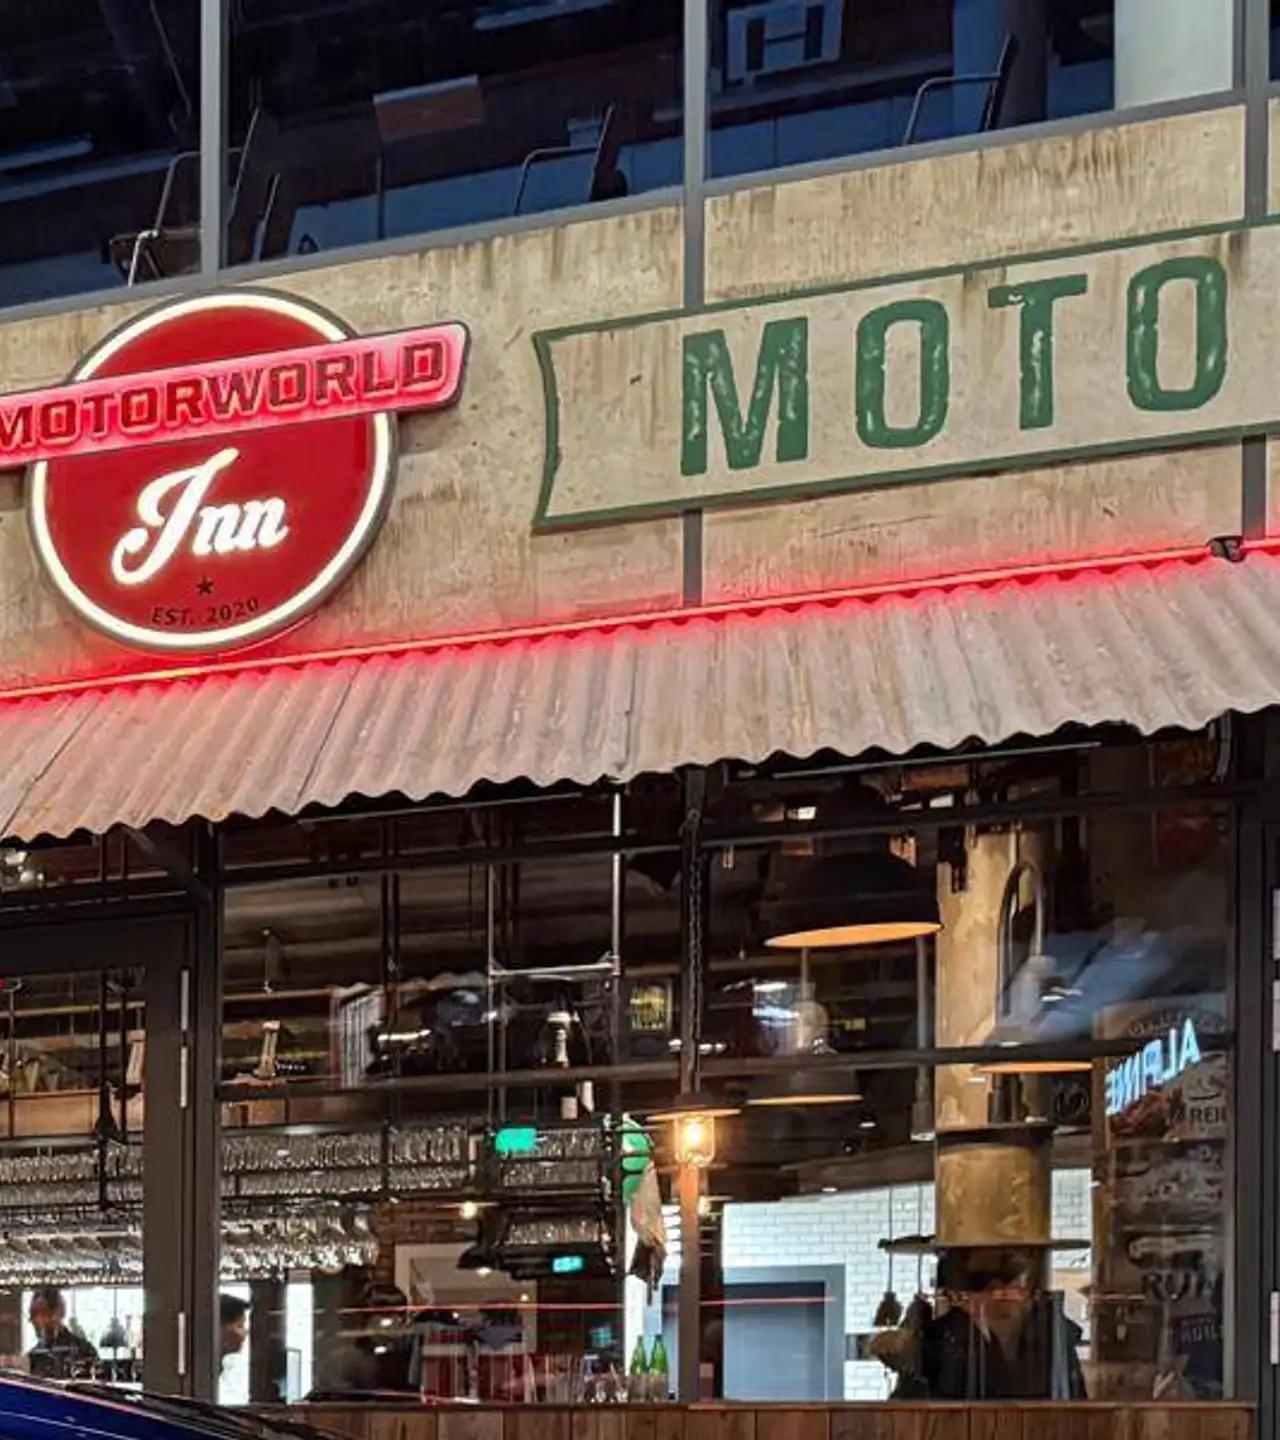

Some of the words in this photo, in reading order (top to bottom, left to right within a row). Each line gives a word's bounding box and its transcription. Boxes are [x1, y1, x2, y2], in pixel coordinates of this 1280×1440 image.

[680, 256, 1228, 476] MOTO
[111, 447, 289, 585] Inn
[206, 597, 261, 622] 2020
